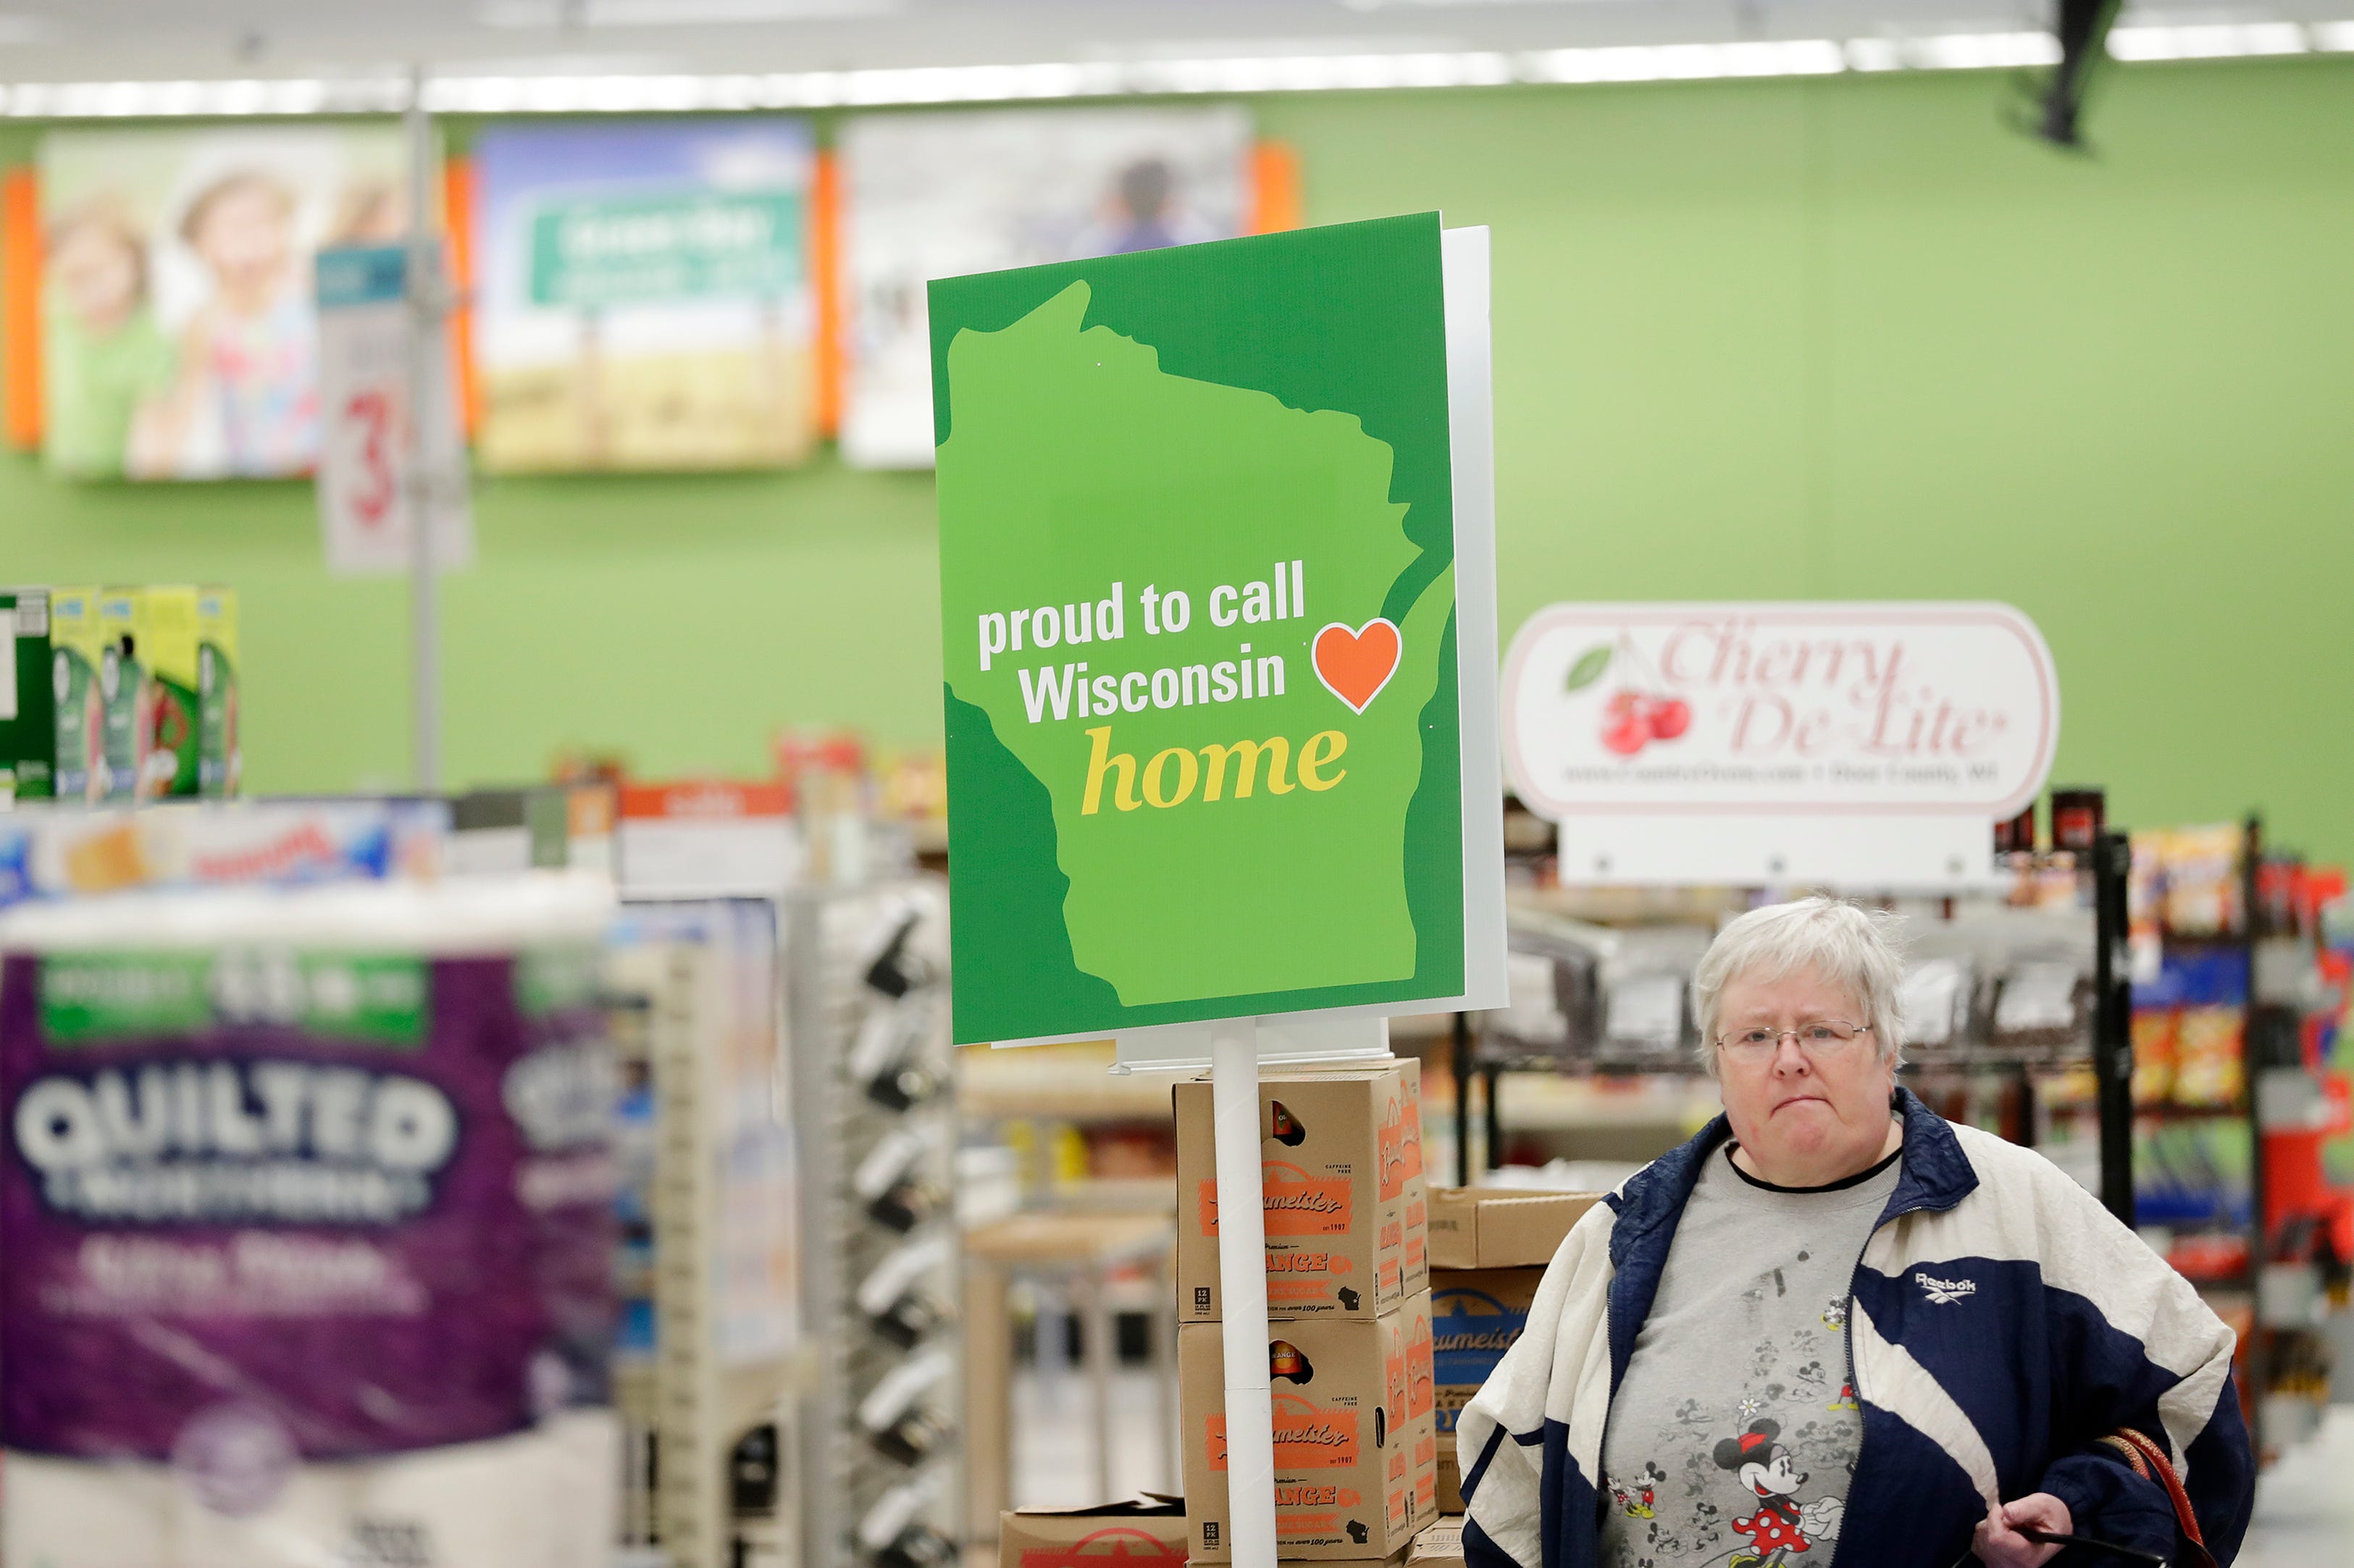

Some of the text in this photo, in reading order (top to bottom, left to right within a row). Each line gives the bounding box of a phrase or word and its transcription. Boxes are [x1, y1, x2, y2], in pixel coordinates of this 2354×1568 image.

[979, 559, 1304, 671] proud to call
[1018, 642, 1286, 724] Wisconsin
[1660, 617, 1906, 710] Cherry
[1081, 726, 1348, 816] home
[14, 1058, 461, 1173] QUILTED
[1266, 1253, 1328, 1273] ANGE
[1915, 1273, 1977, 1291] Reebok
[1433, 1325, 1524, 1351] umeist
[1275, 1485, 1336, 1506] ANGE
